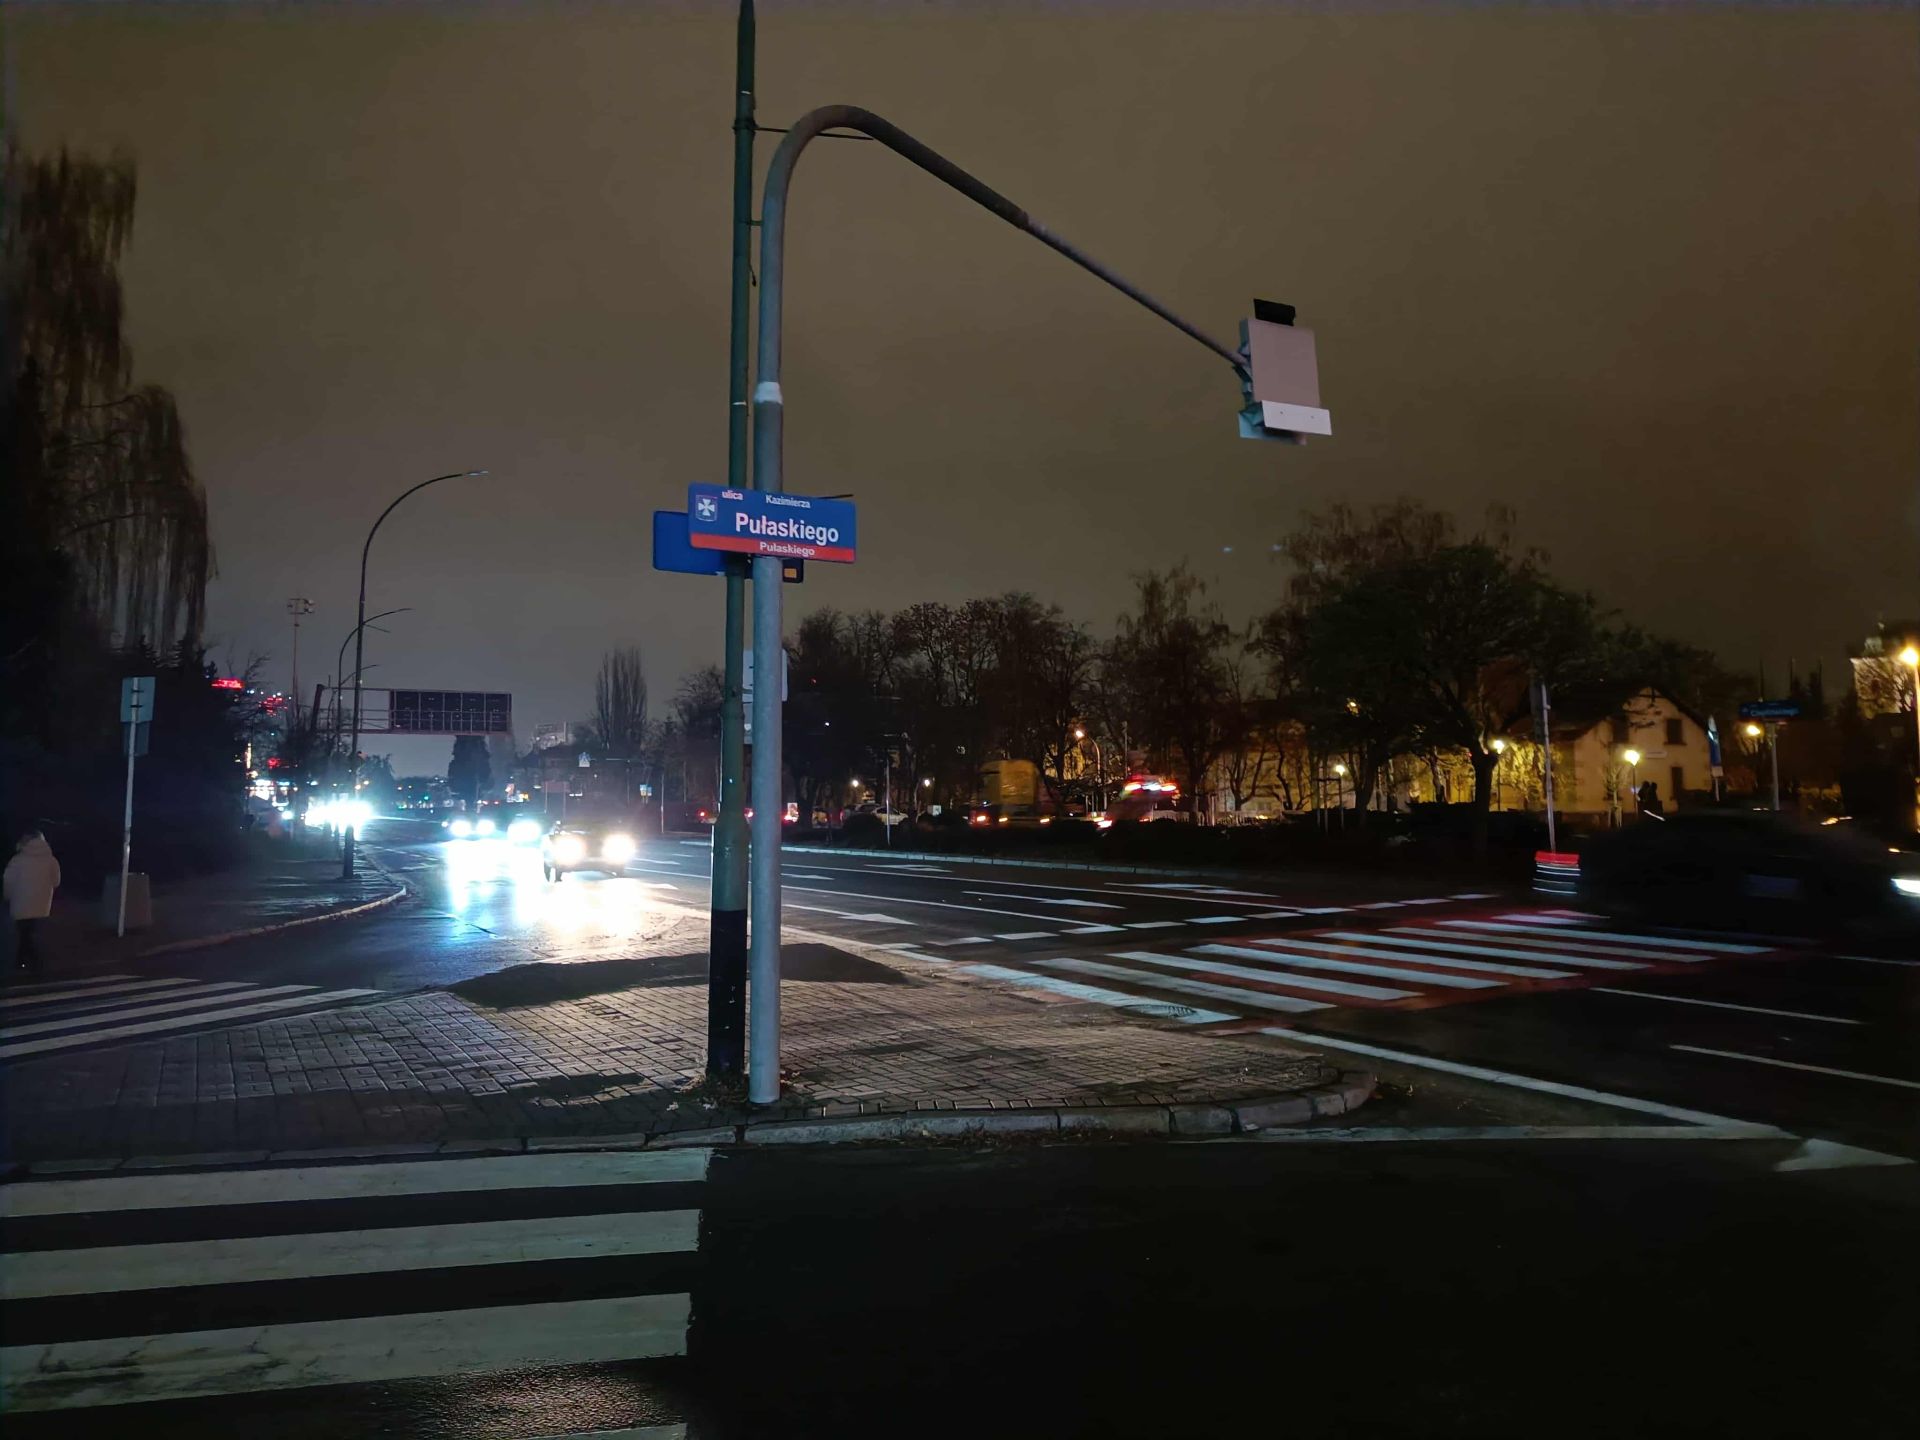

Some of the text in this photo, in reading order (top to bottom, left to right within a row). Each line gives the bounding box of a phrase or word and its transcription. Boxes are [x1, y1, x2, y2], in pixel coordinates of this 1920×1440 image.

[721, 489, 743, 500] ulica
[765, 495, 811, 508] Kazimierza
[735, 512, 839, 545] Pułaskiego
